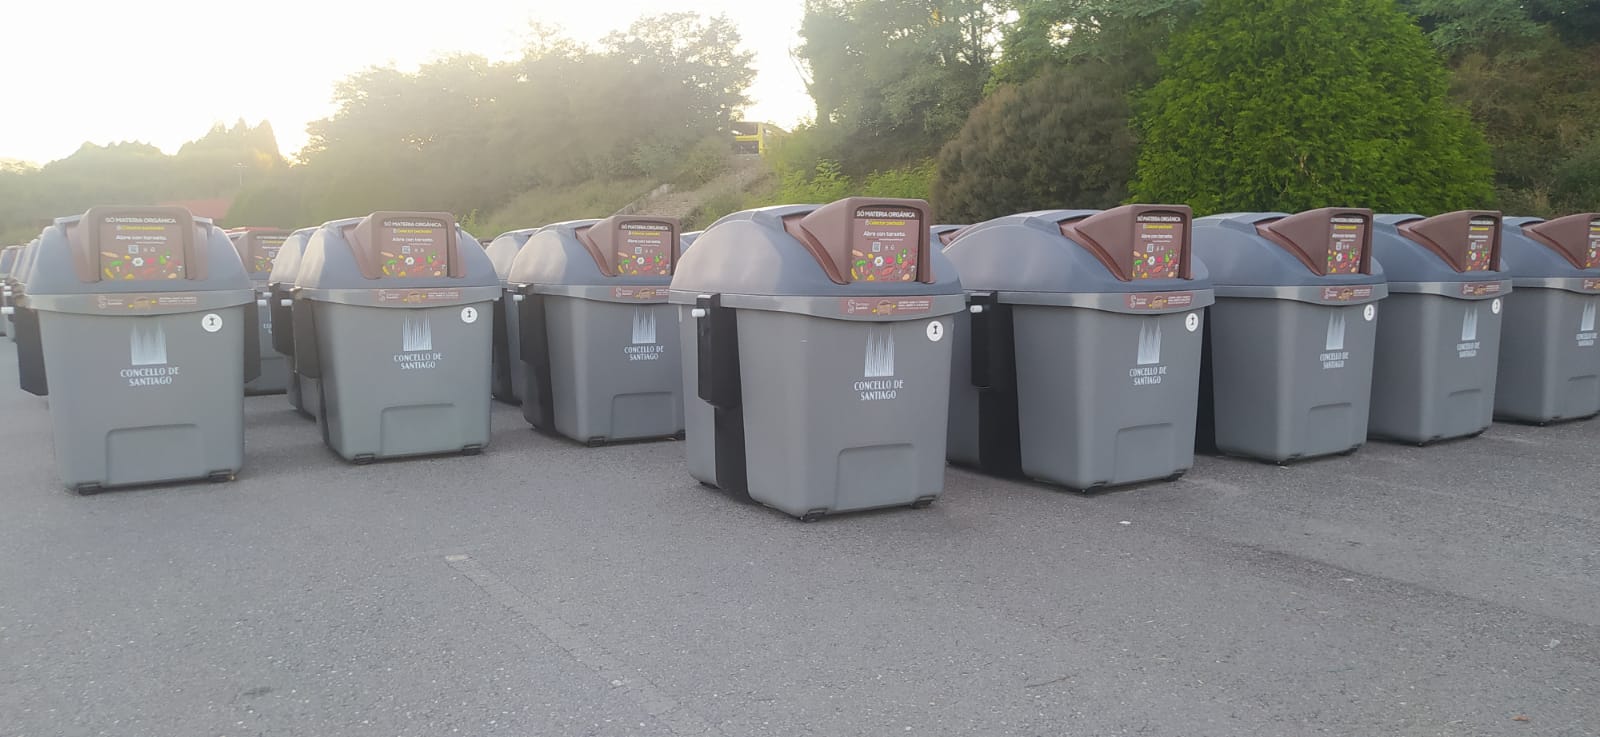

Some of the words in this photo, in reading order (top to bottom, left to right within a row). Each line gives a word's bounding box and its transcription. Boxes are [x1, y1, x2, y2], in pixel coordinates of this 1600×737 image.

[624, 345, 655, 353] CONCELLO
[655, 345, 664, 353] DE
[393, 353, 431, 362] CONCELLO
[432, 352, 442, 360] DE
[629, 353, 659, 361] SANTIAGO
[400, 361, 436, 370] SANTIAGO
[120, 367, 166, 377] CONCELLO
[168, 366, 180, 375] DE
[1129, 367, 1158, 377] CONCELLO
[1158, 366, 1167, 375] DE
[128, 376, 172, 387] SANTIAGO
[854, 380, 892, 391] CONCELLO
[893, 379, 904, 389] DE
[1133, 376, 1161, 385] SANTIAGO
[860, 390, 897, 401] SANTIAGO
